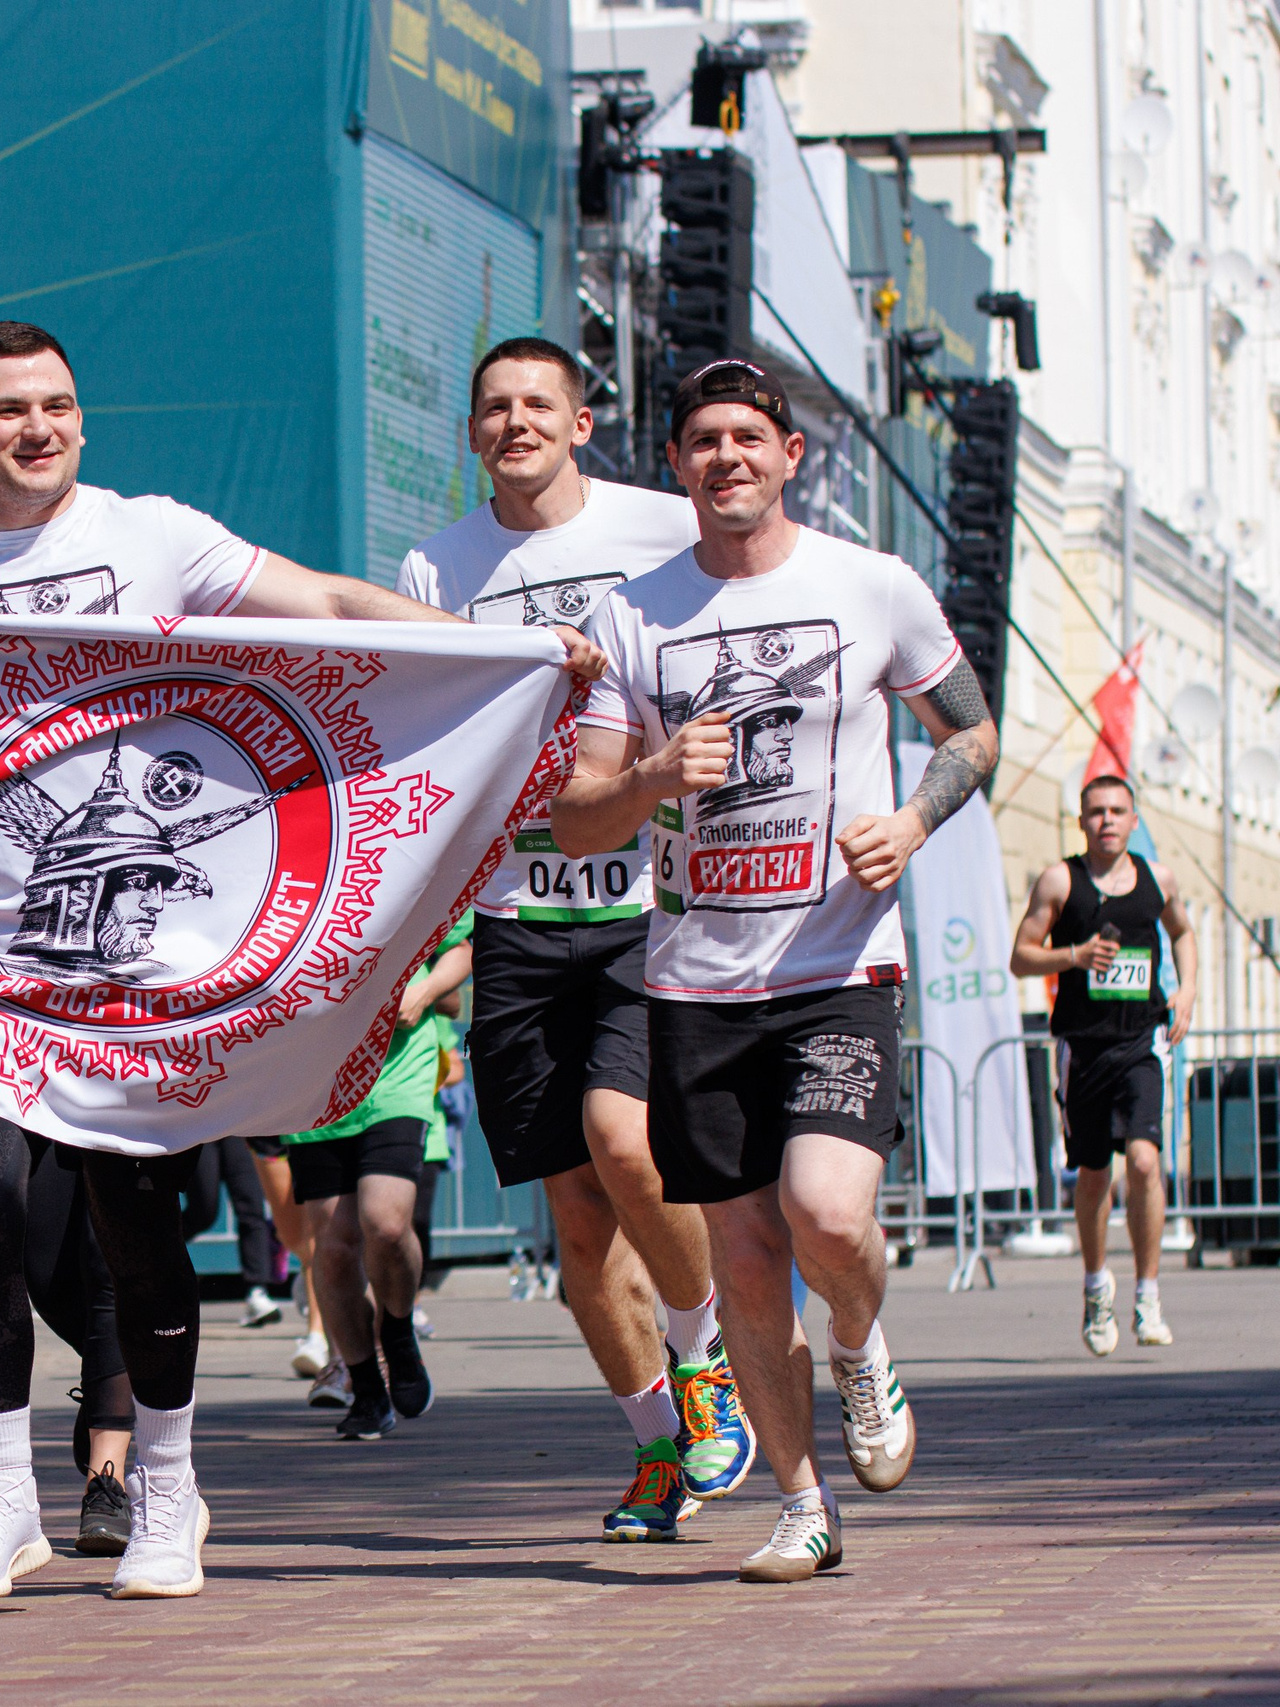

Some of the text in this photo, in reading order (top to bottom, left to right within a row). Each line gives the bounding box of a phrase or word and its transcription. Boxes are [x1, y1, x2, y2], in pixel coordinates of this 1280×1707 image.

[4, 687, 306, 775] СМОЛЕНСКИЕ ВИТЯЗИ
[698, 816, 807, 844] СМОЛЕНСКИЕ
[528, 860, 629, 900] 0410
[698, 849, 804, 890] ВИТЯЗИ
[45, 986, 110, 1018] ВСЕ
[123, 871, 317, 1019] ПРЕВОЗМОЖЕТ
[798, 1044, 881, 1065] EVERYONE
[808, 1034, 876, 1050] NOT FOR
[790, 1091, 865, 1120] MMA
